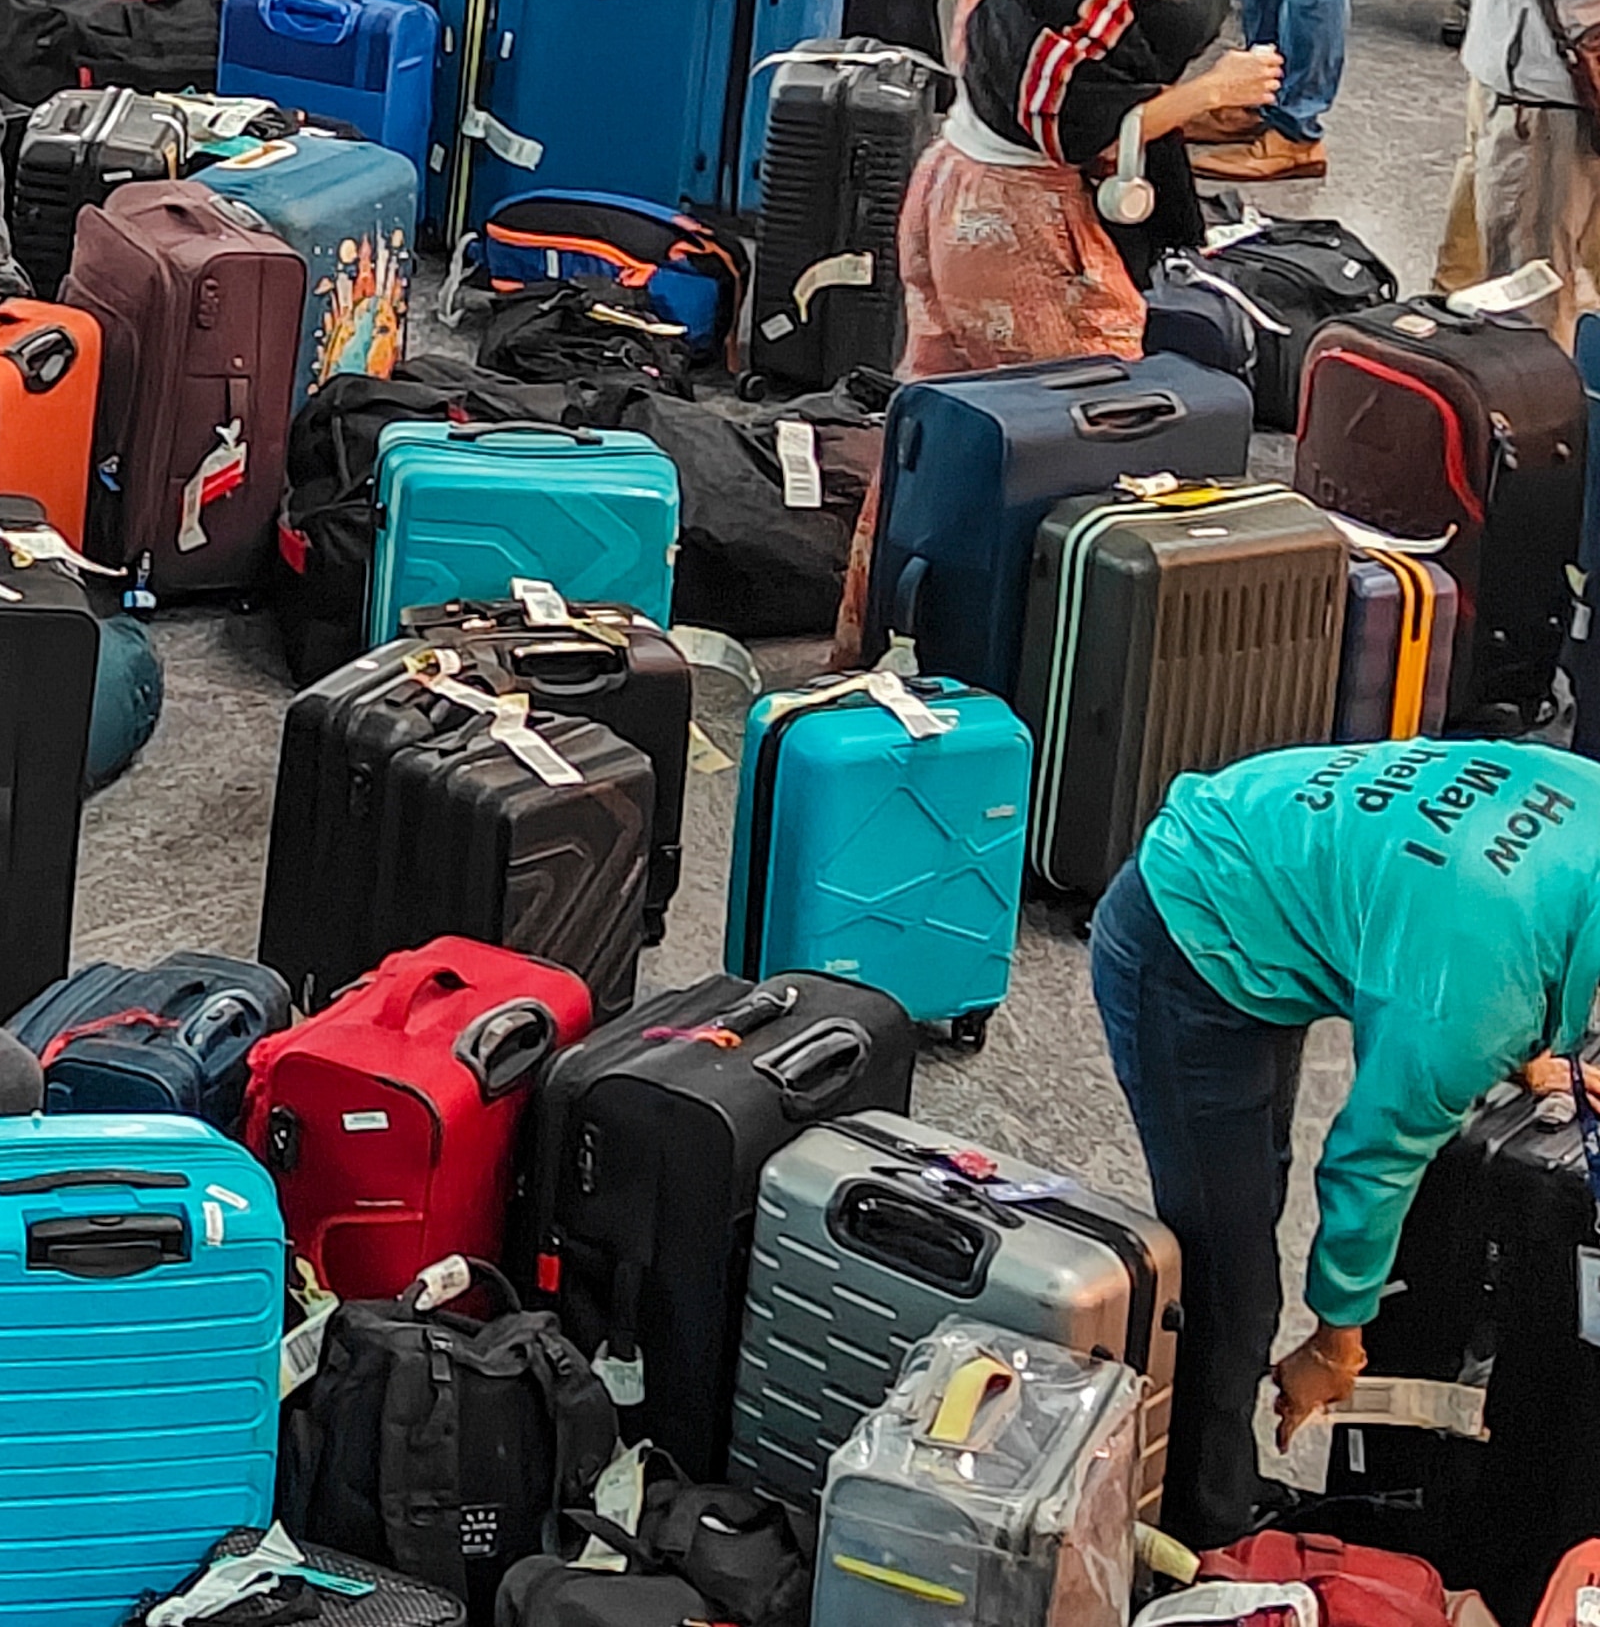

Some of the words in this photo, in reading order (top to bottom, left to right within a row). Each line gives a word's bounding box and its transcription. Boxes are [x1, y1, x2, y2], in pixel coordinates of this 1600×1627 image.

[1355, 749, 1448, 813] help
[1417, 759, 1512, 835] May
[1403, 840, 1448, 868] I
[1483, 783, 1577, 877] How
